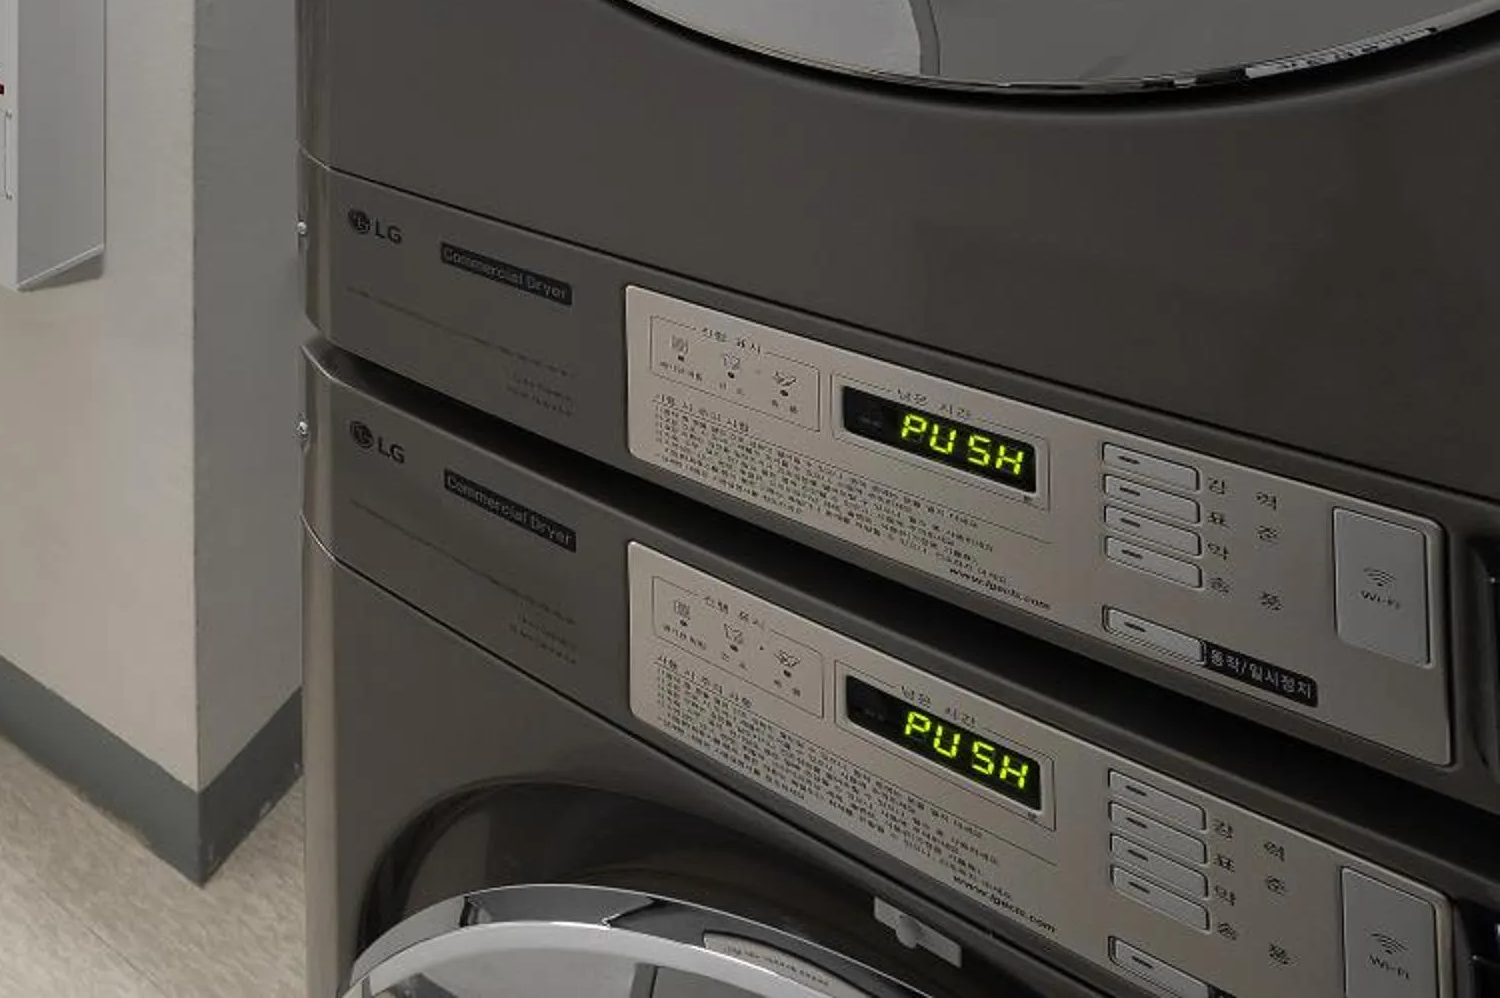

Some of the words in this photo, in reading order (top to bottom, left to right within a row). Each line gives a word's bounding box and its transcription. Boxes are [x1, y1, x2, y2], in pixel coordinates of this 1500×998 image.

[374, 218, 402, 244] LG
[443, 246, 521, 283] Commercial
[525, 276, 567, 299] Dryer
[378, 437, 406, 464] LG
[901, 413, 1025, 475] PUSH
[447, 474, 526, 523] Commercial
[530, 513, 572, 547] Dryer
[904, 711, 1029, 789] PUSH
